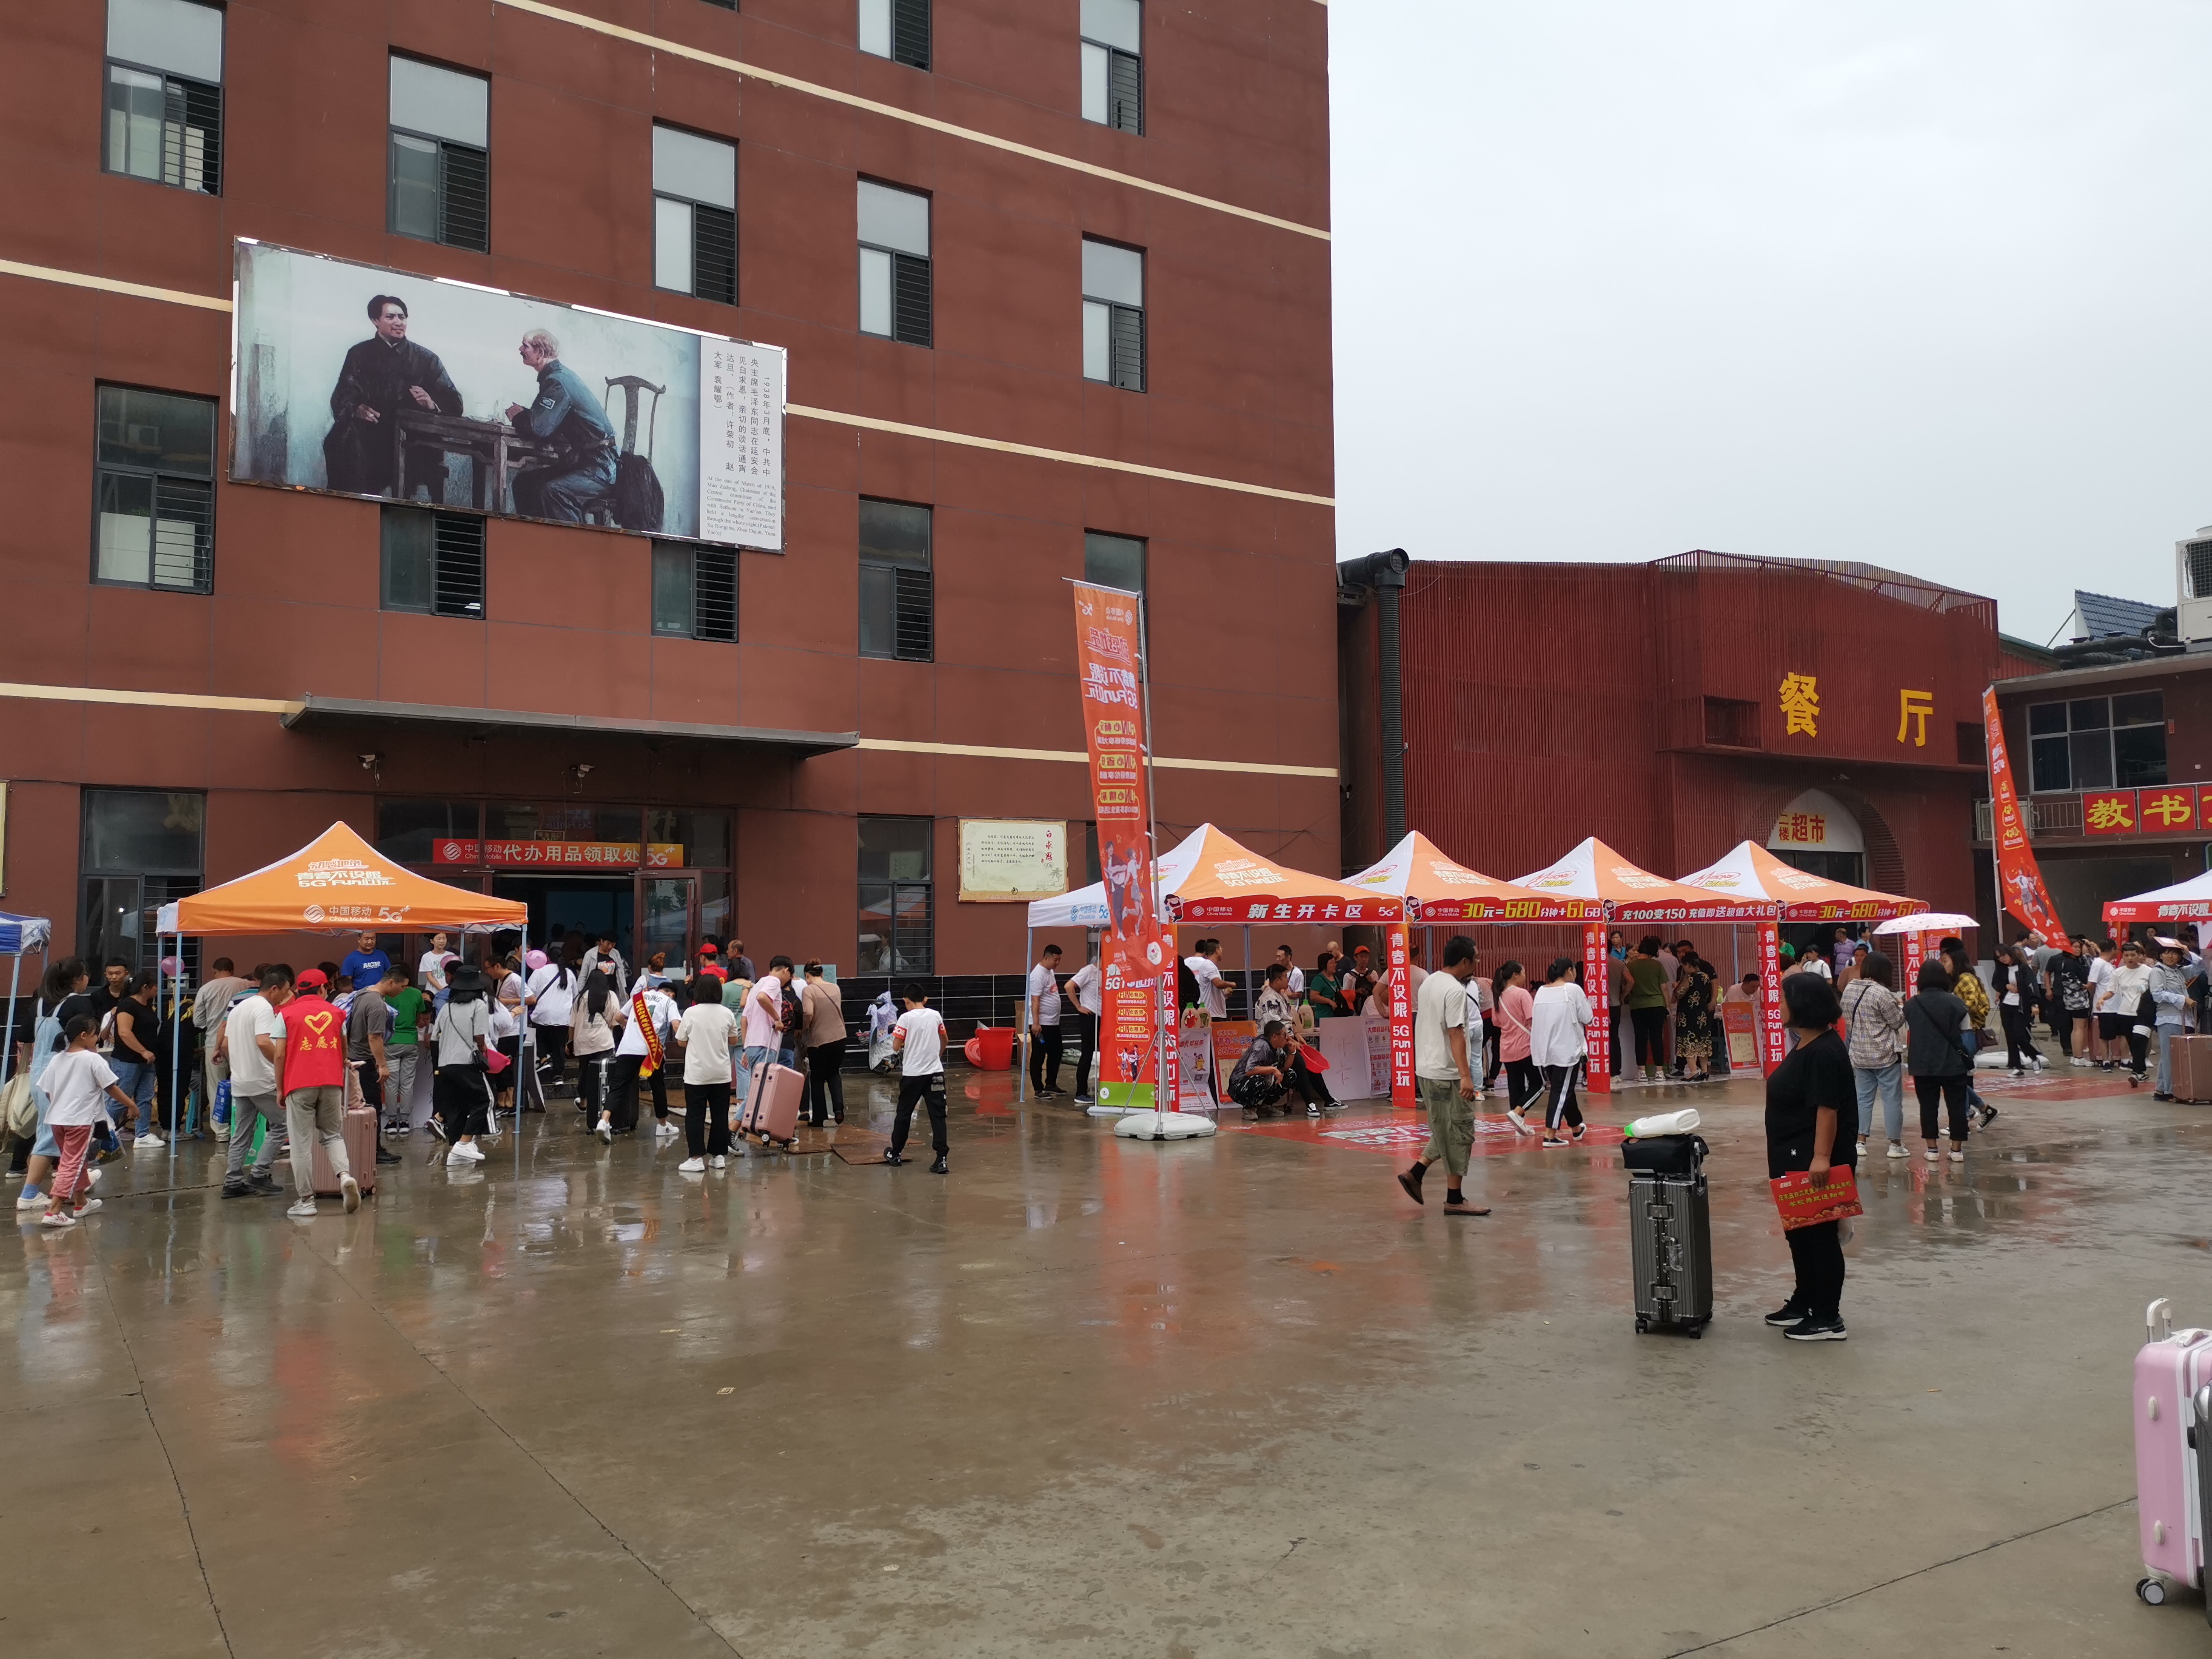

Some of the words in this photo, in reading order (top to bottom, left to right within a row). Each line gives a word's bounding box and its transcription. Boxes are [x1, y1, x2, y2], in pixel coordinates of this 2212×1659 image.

[714, 351, 722, 369] 大军
[750, 358, 759, 475] 央主席毛泽东同志在延安会
[1778, 672, 1933, 747] 餐厅
[2086, 794, 2212, 829] 教书
[1791, 813, 1825, 843] 超市
[503, 843, 640, 863] 代办用品领取处
[308, 859, 369, 871] 动感地带
[295, 871, 395, 882] 青春不设限
[329, 906, 371, 916] 中国移动
[1247, 903, 1363, 919] 新生开卡区
[1688, 905, 1776, 919] 充值即送超值大礼包
[2157, 903, 2212, 920] 青春不设限
[1390, 933, 1407, 1017] 青春不设限
[1765, 930, 1779, 1003] 青春不设限
[300, 1036, 338, 1051] 志愿者
